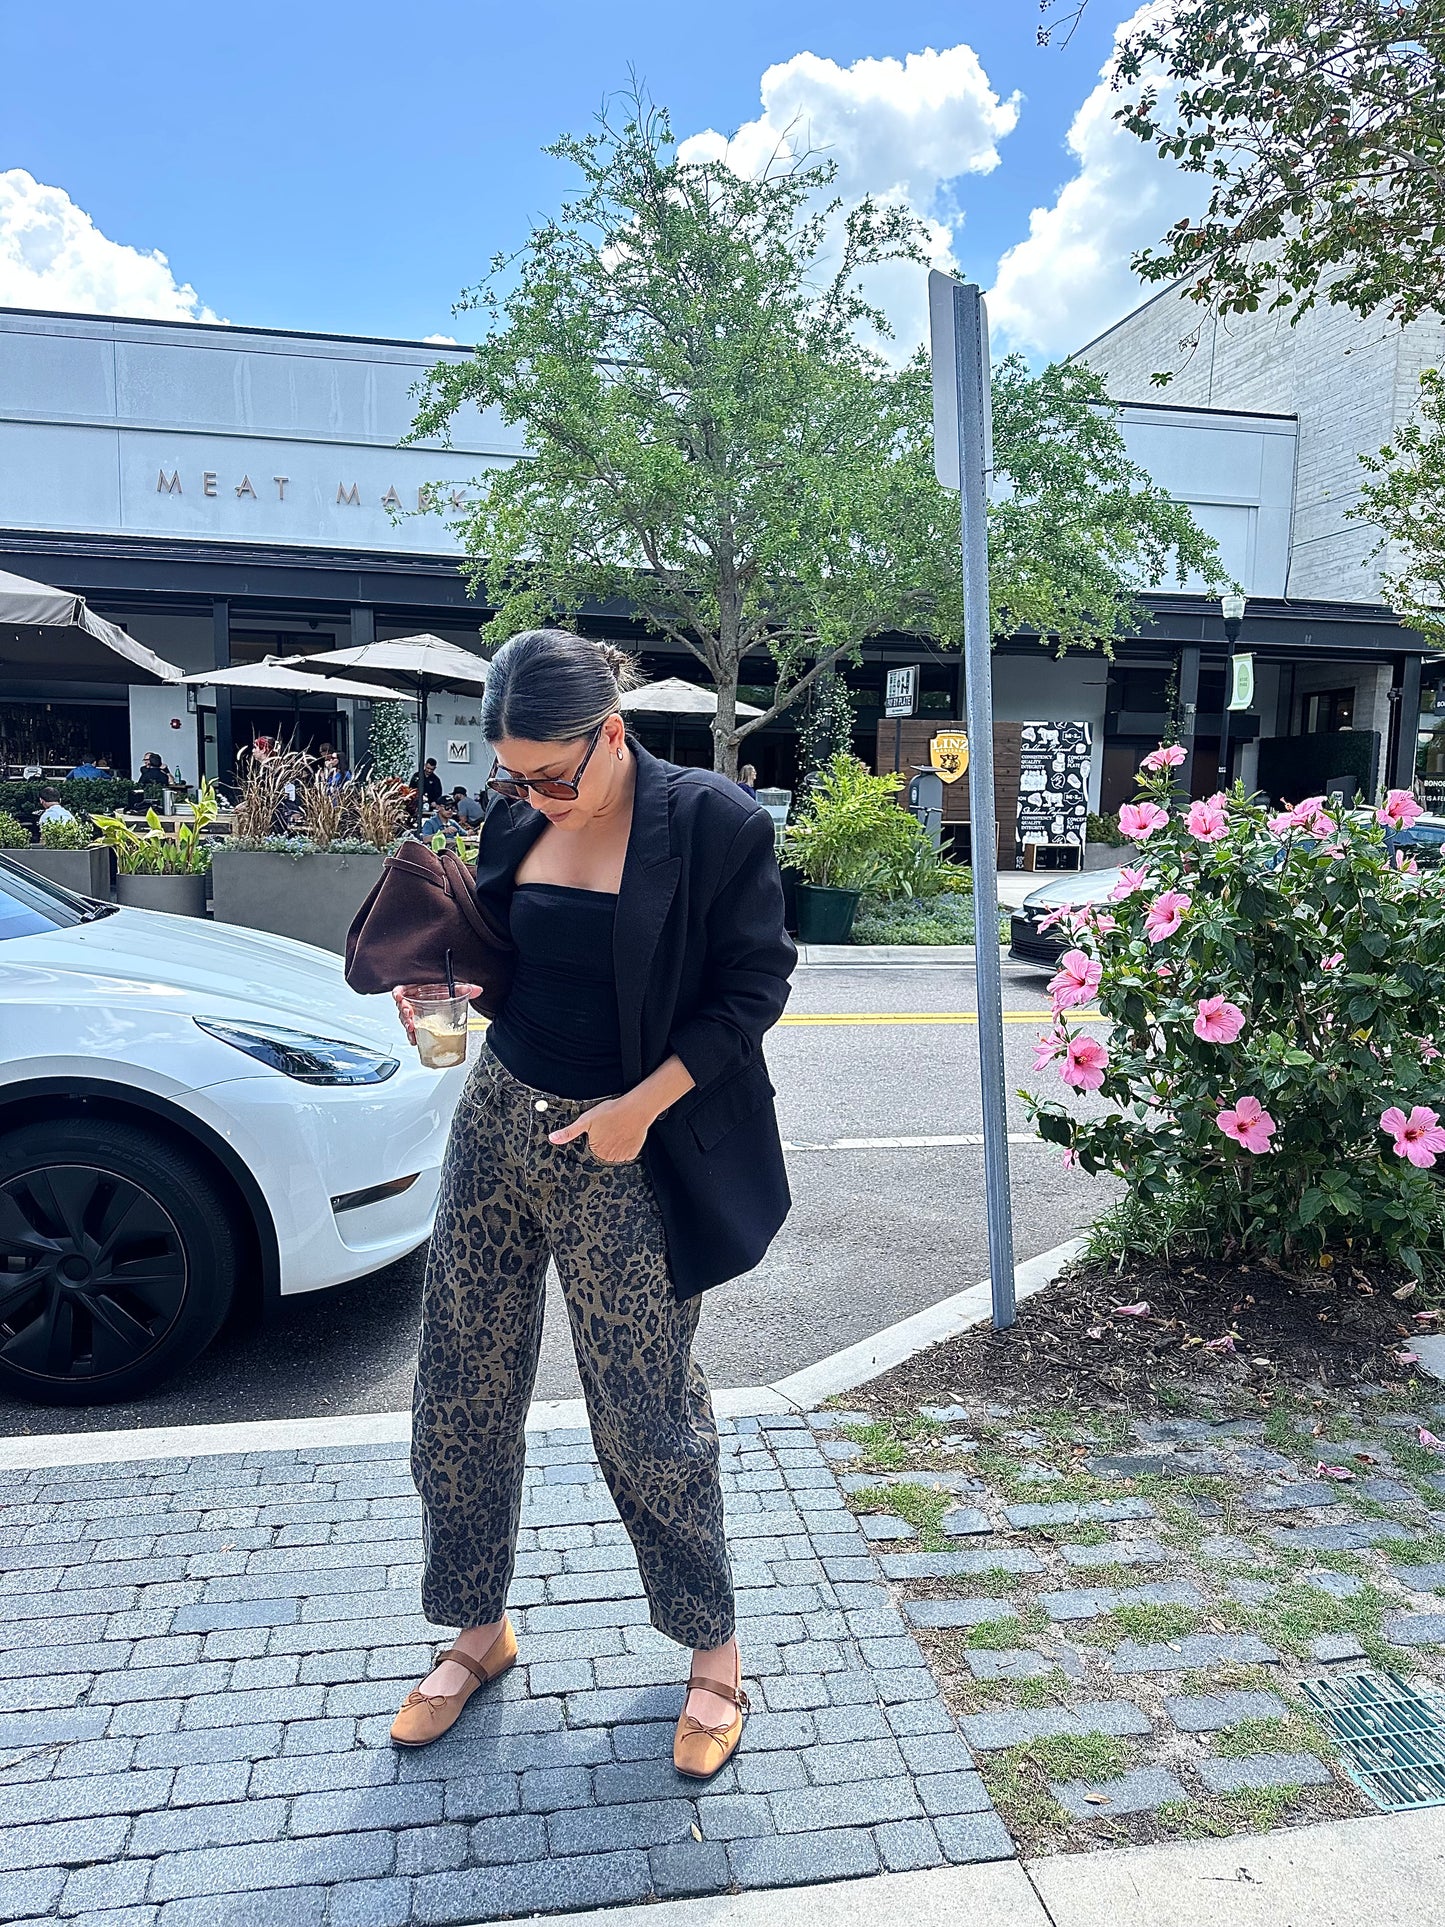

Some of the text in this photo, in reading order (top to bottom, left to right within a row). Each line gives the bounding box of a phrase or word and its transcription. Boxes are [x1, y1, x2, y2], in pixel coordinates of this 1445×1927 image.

[157, 469, 498, 516] MEAT MARK
[932, 739, 969, 750] LINZ
